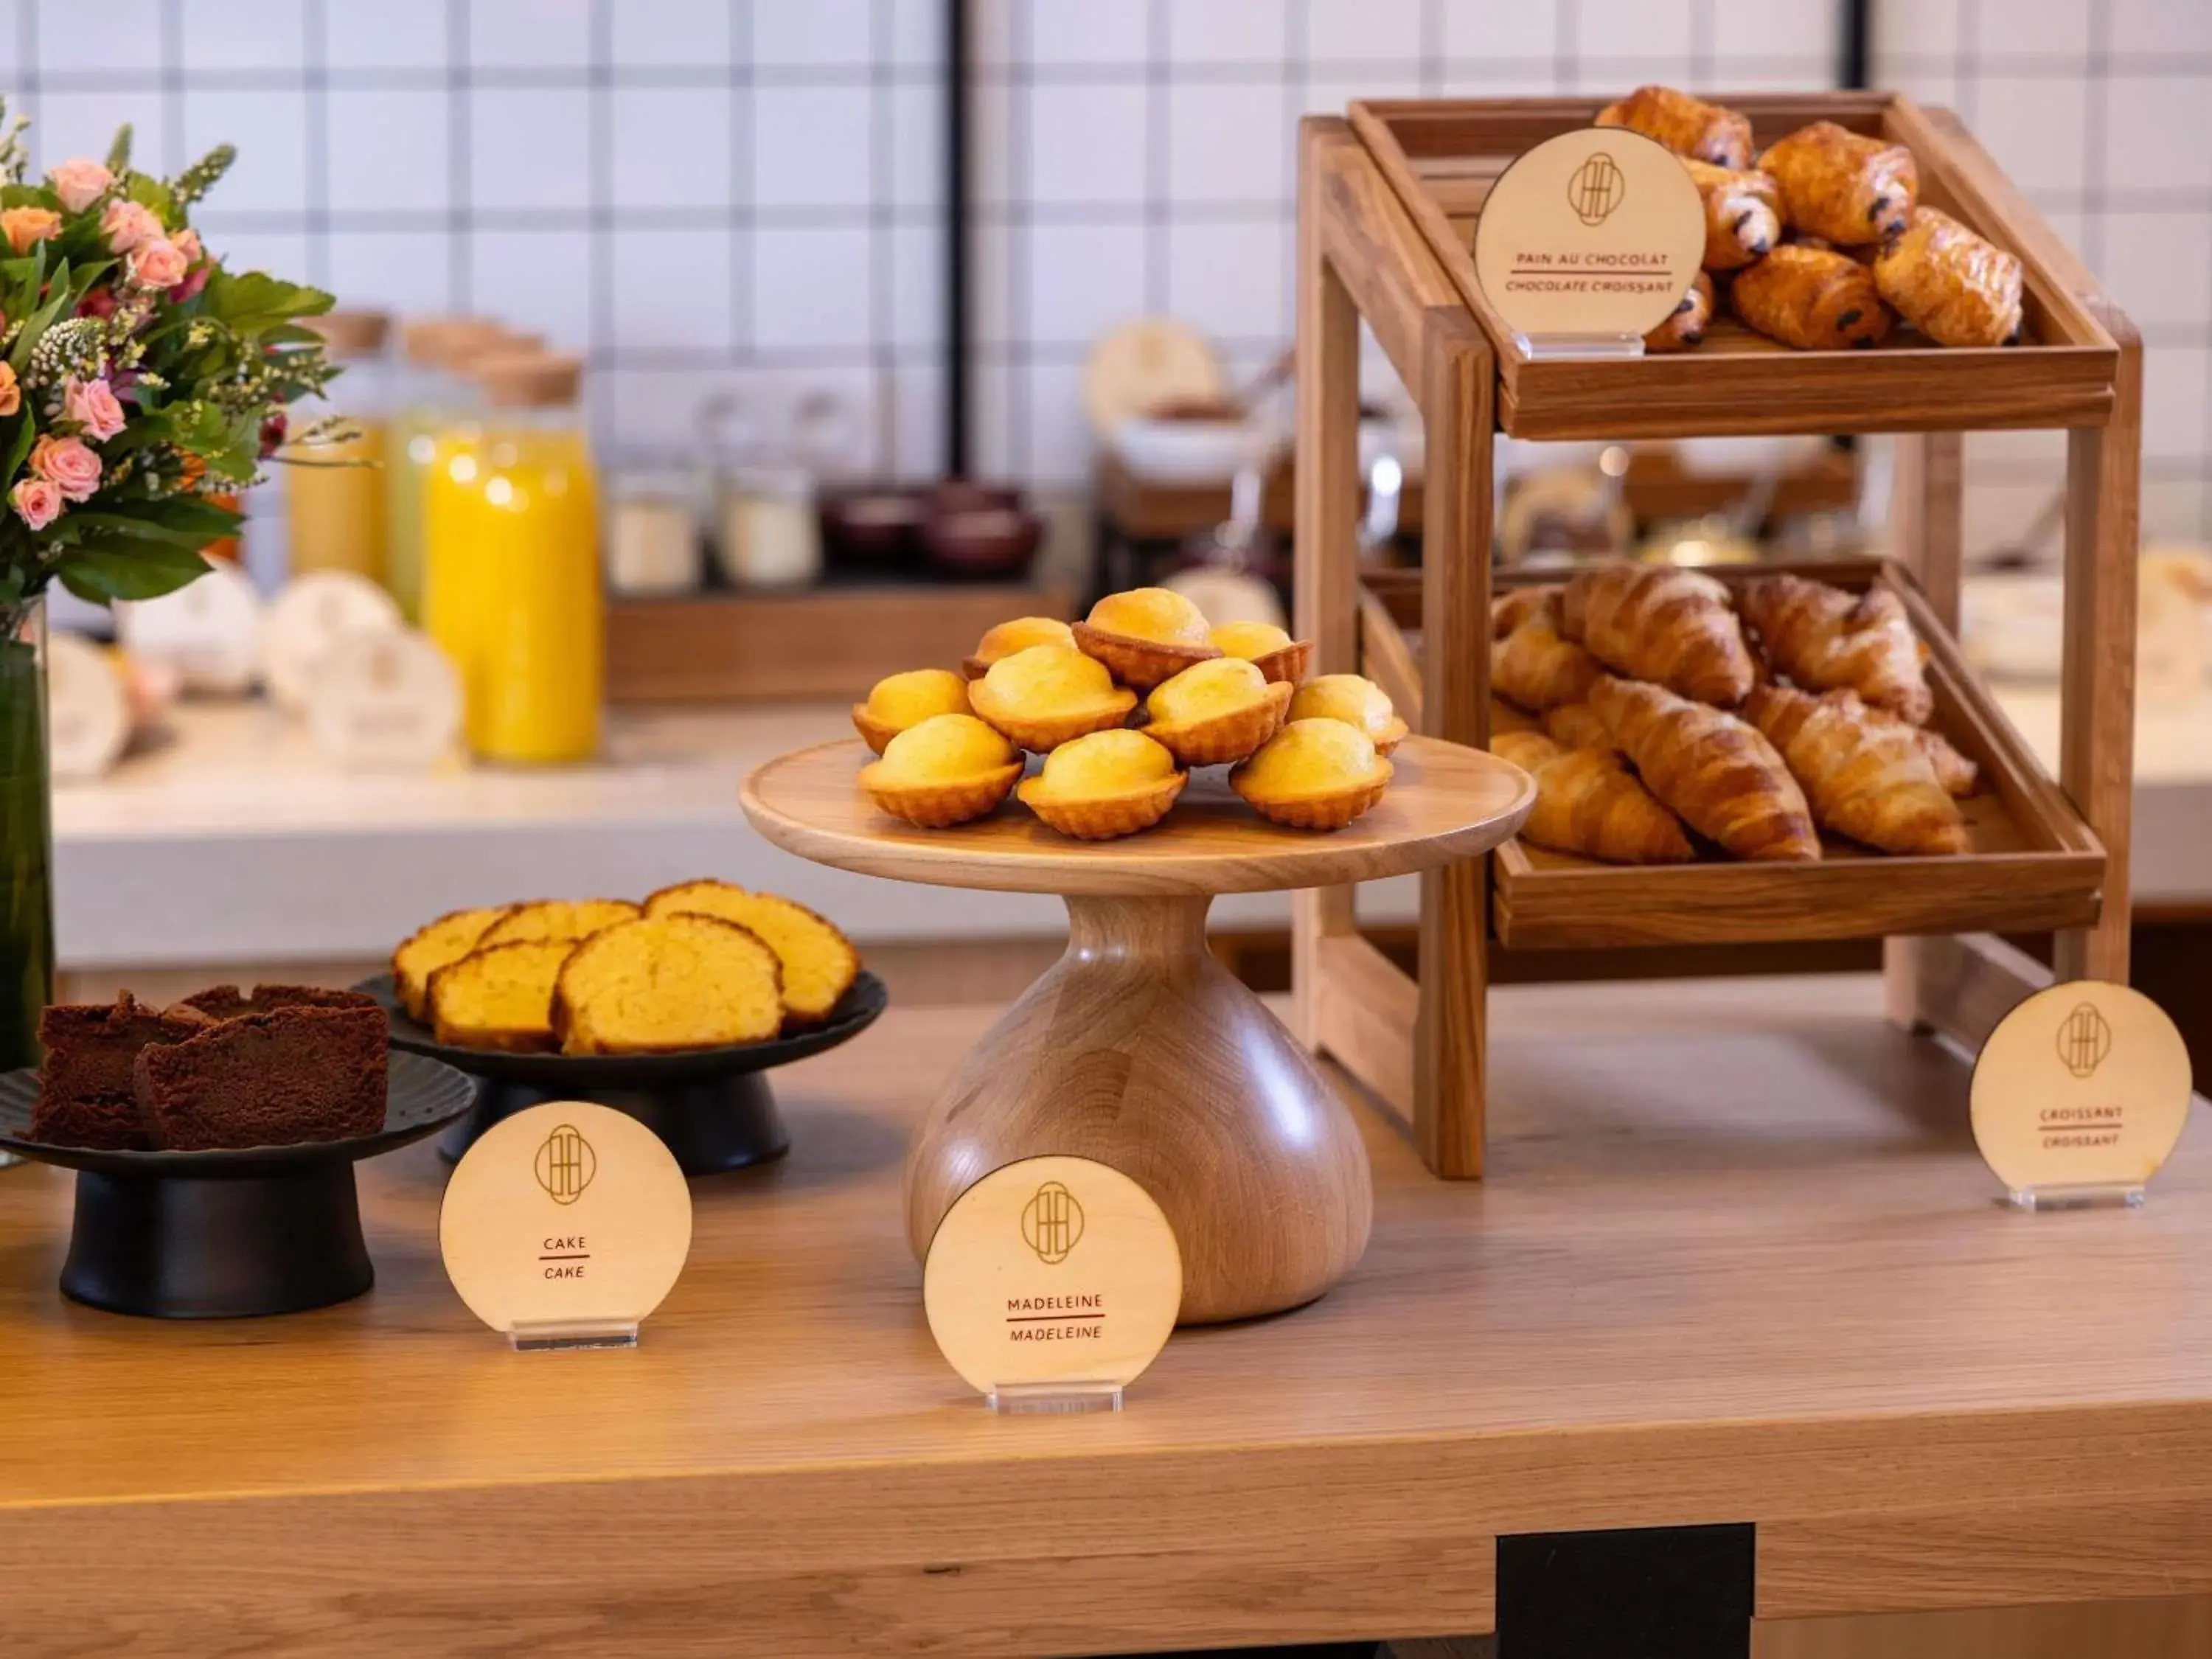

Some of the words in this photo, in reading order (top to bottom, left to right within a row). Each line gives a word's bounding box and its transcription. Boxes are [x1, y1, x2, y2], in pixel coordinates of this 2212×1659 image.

[1516, 253, 1553, 265] PAIN
[1558, 253, 1579, 265] AU
[1585, 253, 1669, 266] CHOCOLAT
[1505, 280, 1587, 293] CHOCOLATE
[1591, 281, 1674, 294] CROISSANT
[2039, 1106, 2123, 1121] CROISSANT
[543, 1237, 586, 1250] CAKE
[545, 1265, 585, 1279] CAKE
[1007, 1294, 1104, 1311] MADELEINE
[1010, 1326, 1102, 1341] MADELEINE
